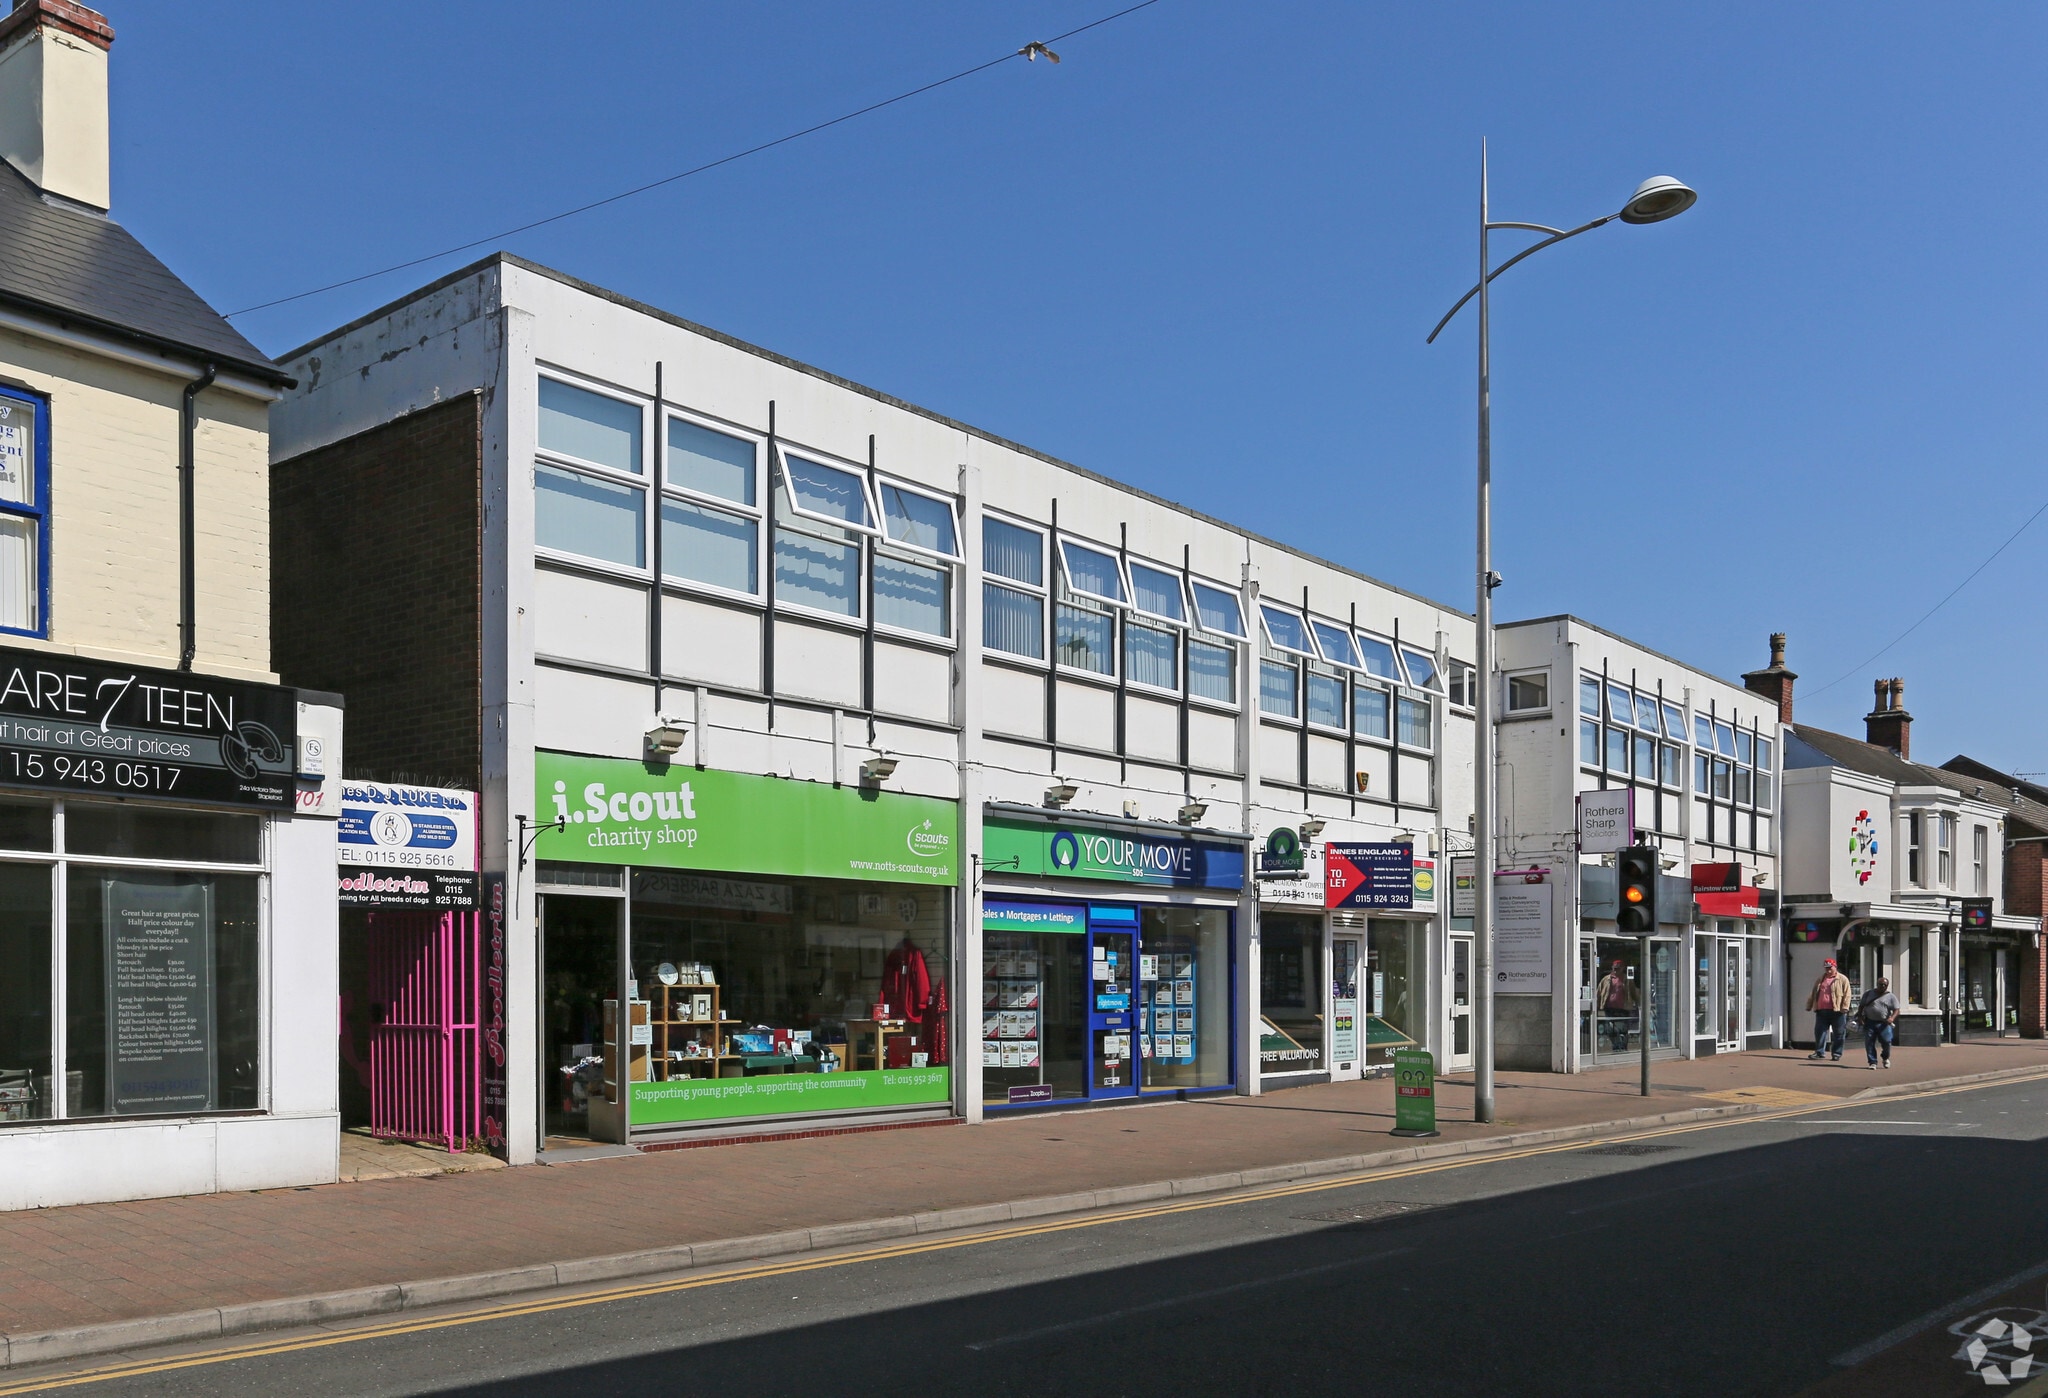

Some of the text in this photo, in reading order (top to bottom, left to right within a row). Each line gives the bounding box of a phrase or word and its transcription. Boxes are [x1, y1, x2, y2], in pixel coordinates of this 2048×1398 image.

[14, 721, 49, 742] hair
[55, 729, 75, 745] at
[80, 730, 133, 751] Great
[137, 739, 191, 757] prices
[53, 757, 106, 784] 943
[115, 763, 181, 790] 0517
[251, 785, 269, 793] Victoria
[399, 788, 438, 804] LUKE
[441, 796, 460, 805] LTD
[552, 780, 697, 824] i.Scout
[1585, 807, 1625, 817] Rothera
[1585, 819, 1616, 829] Sharp
[587, 824, 698, 851] charity shop
[915, 832, 949, 845] scouts
[1586, 830, 1619, 838] Solicitors
[366, 850, 395, 863] 0115
[400, 852, 421, 864] 925
[426, 853, 454, 866] 5616
[1082, 836, 1191, 871] YOUR MOVE
[850, 860, 949, 878] www.notts-scouts.org.uk
[1330, 869, 1342, 878] TO
[435, 875, 472, 884] Telephone:
[1330, 879, 1347, 888] LET
[445, 885, 463, 894] 0115
[370, 894, 380, 902] All
[435, 896, 472, 905] 925 7888
[1307, 892, 1323, 900] 1166
[1355, 895, 1371, 903] 0115
[1374, 895, 1387, 903] 924
[1391, 895, 1409, 903] 3243
[121, 909, 140, 917] Great
[163, 911, 180, 919] great
[181, 911, 199, 919] prices
[1006, 910, 1042, 922] Mortgages
[1049, 912, 1074, 924] Lettings
[143, 919, 160, 927] price
[183, 920, 194, 928] day
[1278, 1048, 1319, 1061] VALUATIONS
[883, 1073, 943, 1086] Tel: 0115 952 3617
[635, 1076, 867, 1103] Supporting young people, supporting the community
